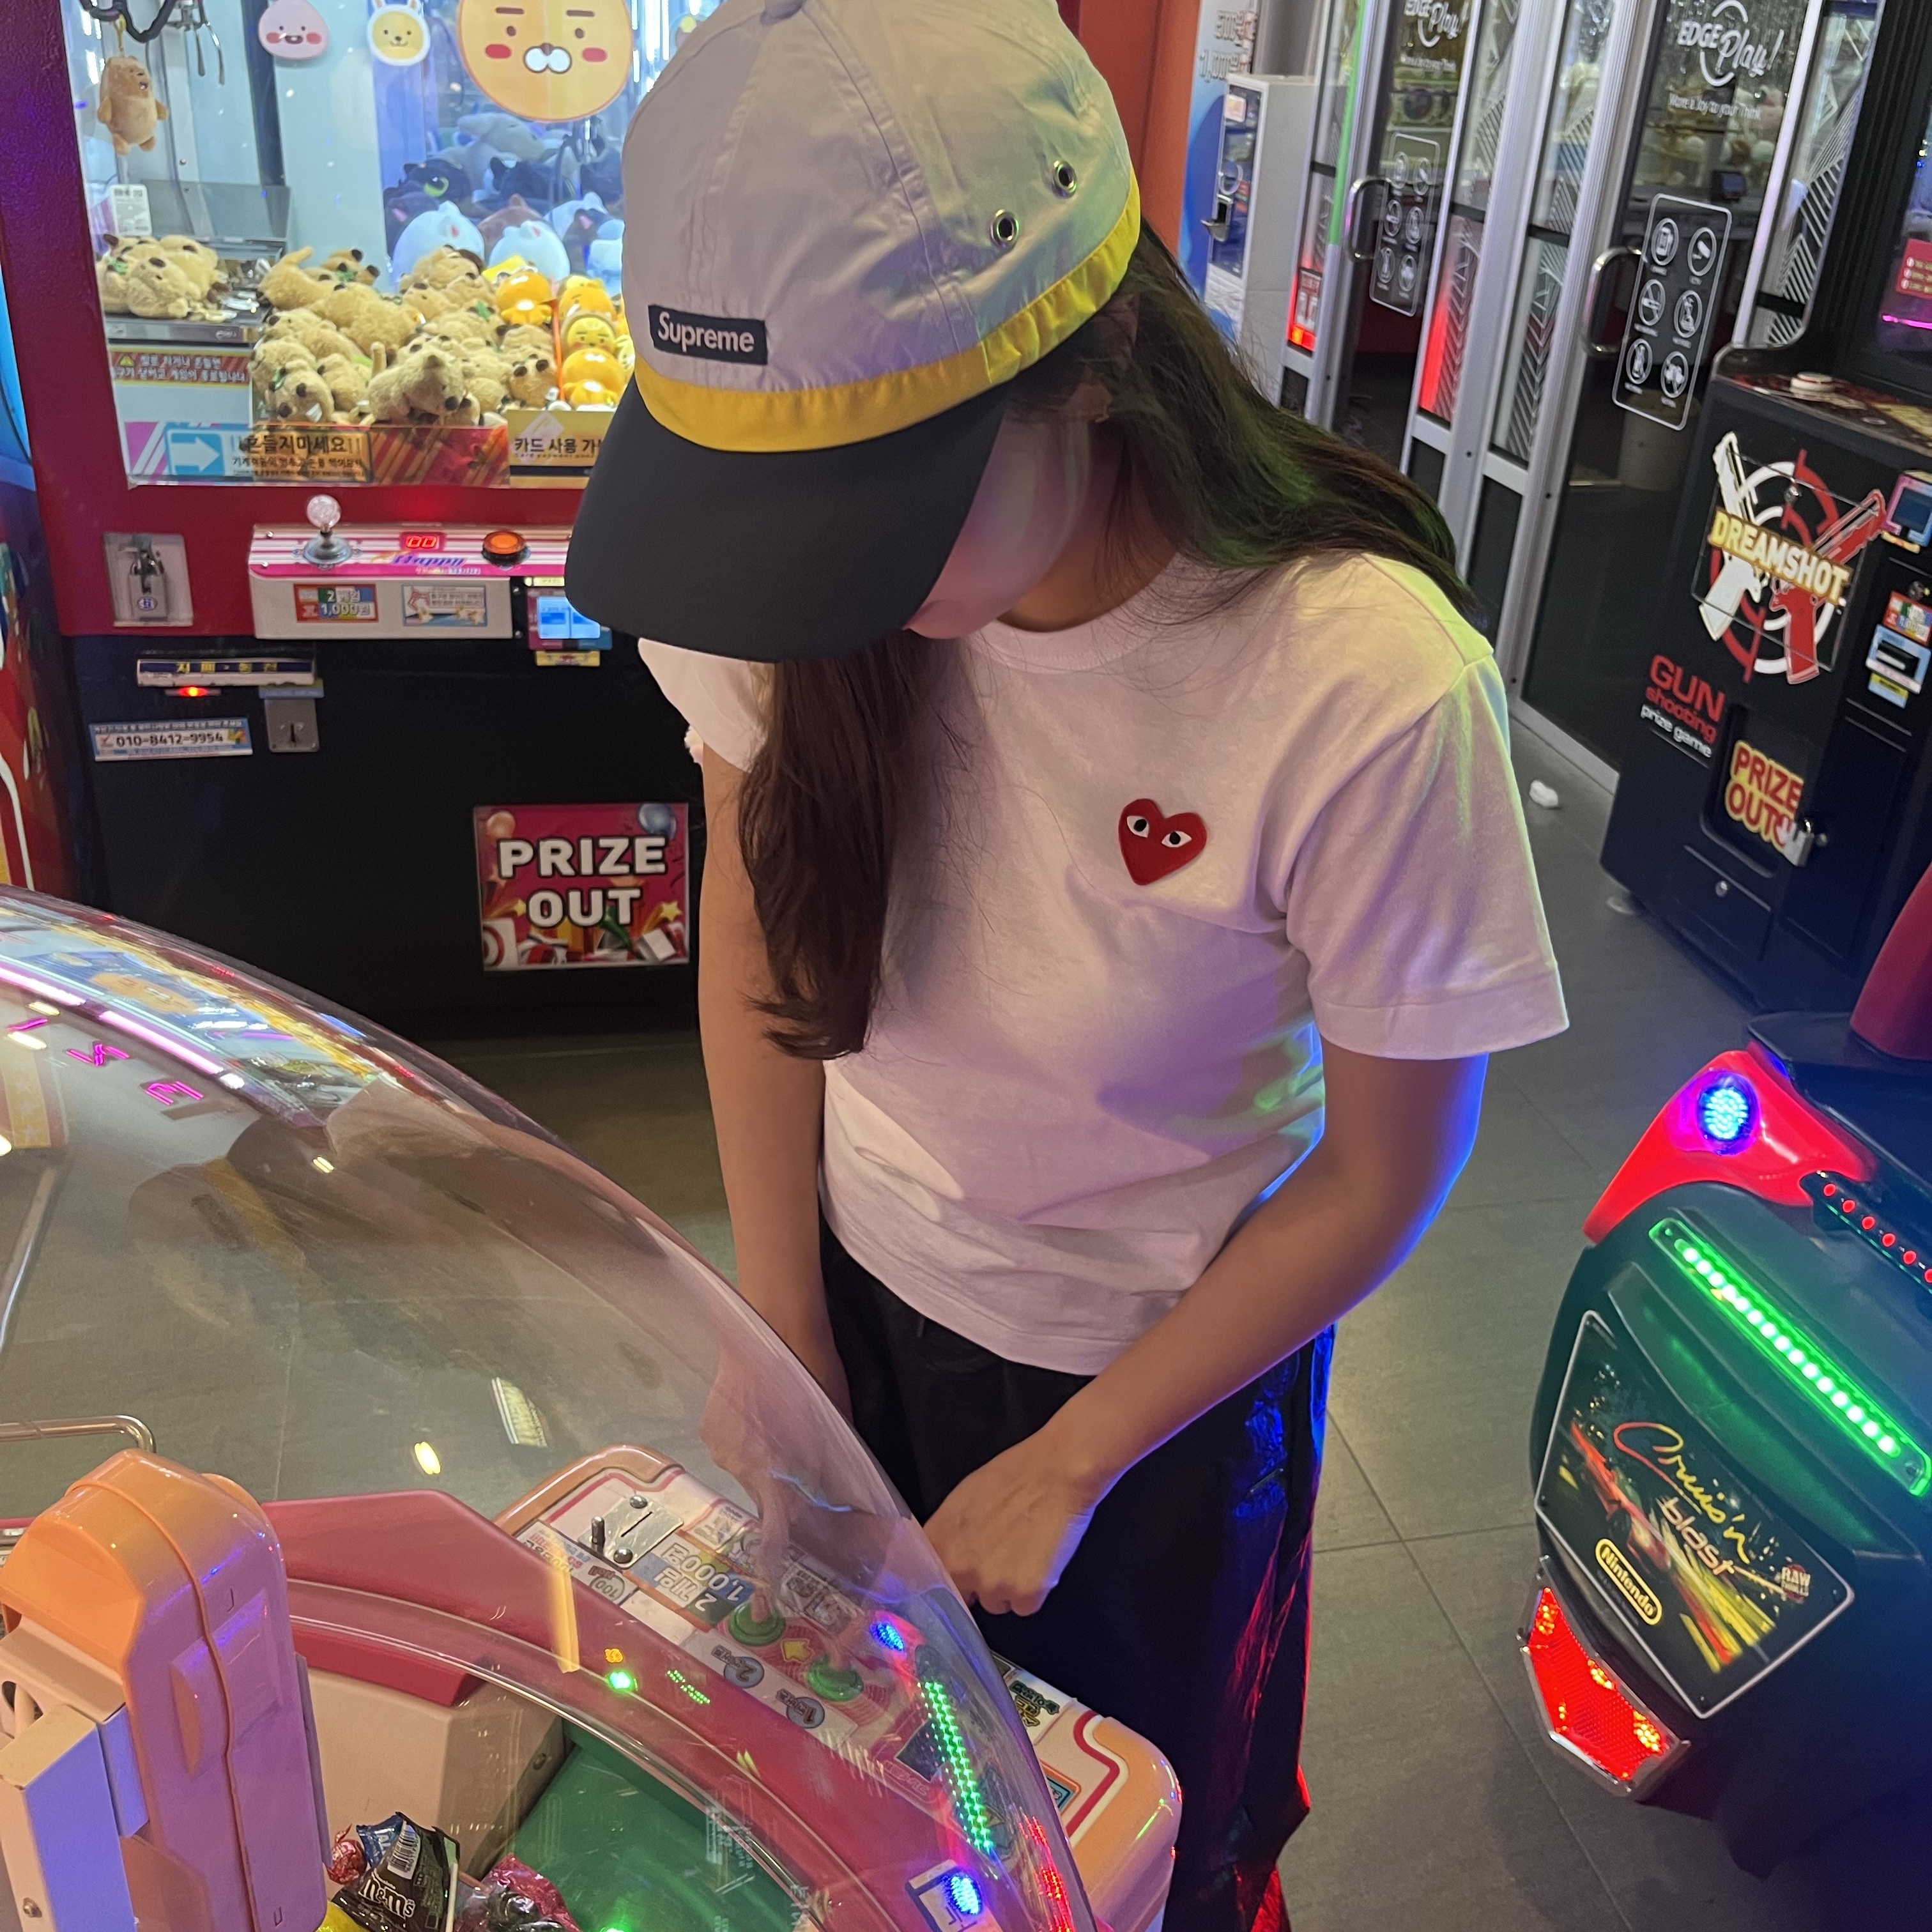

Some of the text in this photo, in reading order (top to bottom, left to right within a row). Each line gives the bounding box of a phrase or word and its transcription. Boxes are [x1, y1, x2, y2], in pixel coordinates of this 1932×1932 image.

[1678, 20, 1784, 77] EDGE Play!
[657, 311, 755, 352] Supreme
[515, 438, 602, 456] 카드 사용 가
[406, 535, 437, 548] 00
[1711, 510, 1851, 604] DREAMSHOT
[327, 590, 335, 602] 2
[1645, 686, 1717, 744] shooting
[1650, 654, 1725, 722] GUN
[1641, 704, 1712, 758] prize game
[1734, 746, 1803, 814] PRIZE
[498, 837, 666, 878] PRIZE
[528, 888, 641, 927] OUT
[1614, 1422, 1750, 1564] Cruis'n
[1657, 1497, 1751, 1581] blast
[595, 1580, 618, 1598] 100
[653, 1567, 717, 1611] 2 게임
[661, 1542, 744, 1602] 1,000원
[1602, 1546, 1655, 1618] Nintendo
[1781, 1567, 1811, 1586] RAW
